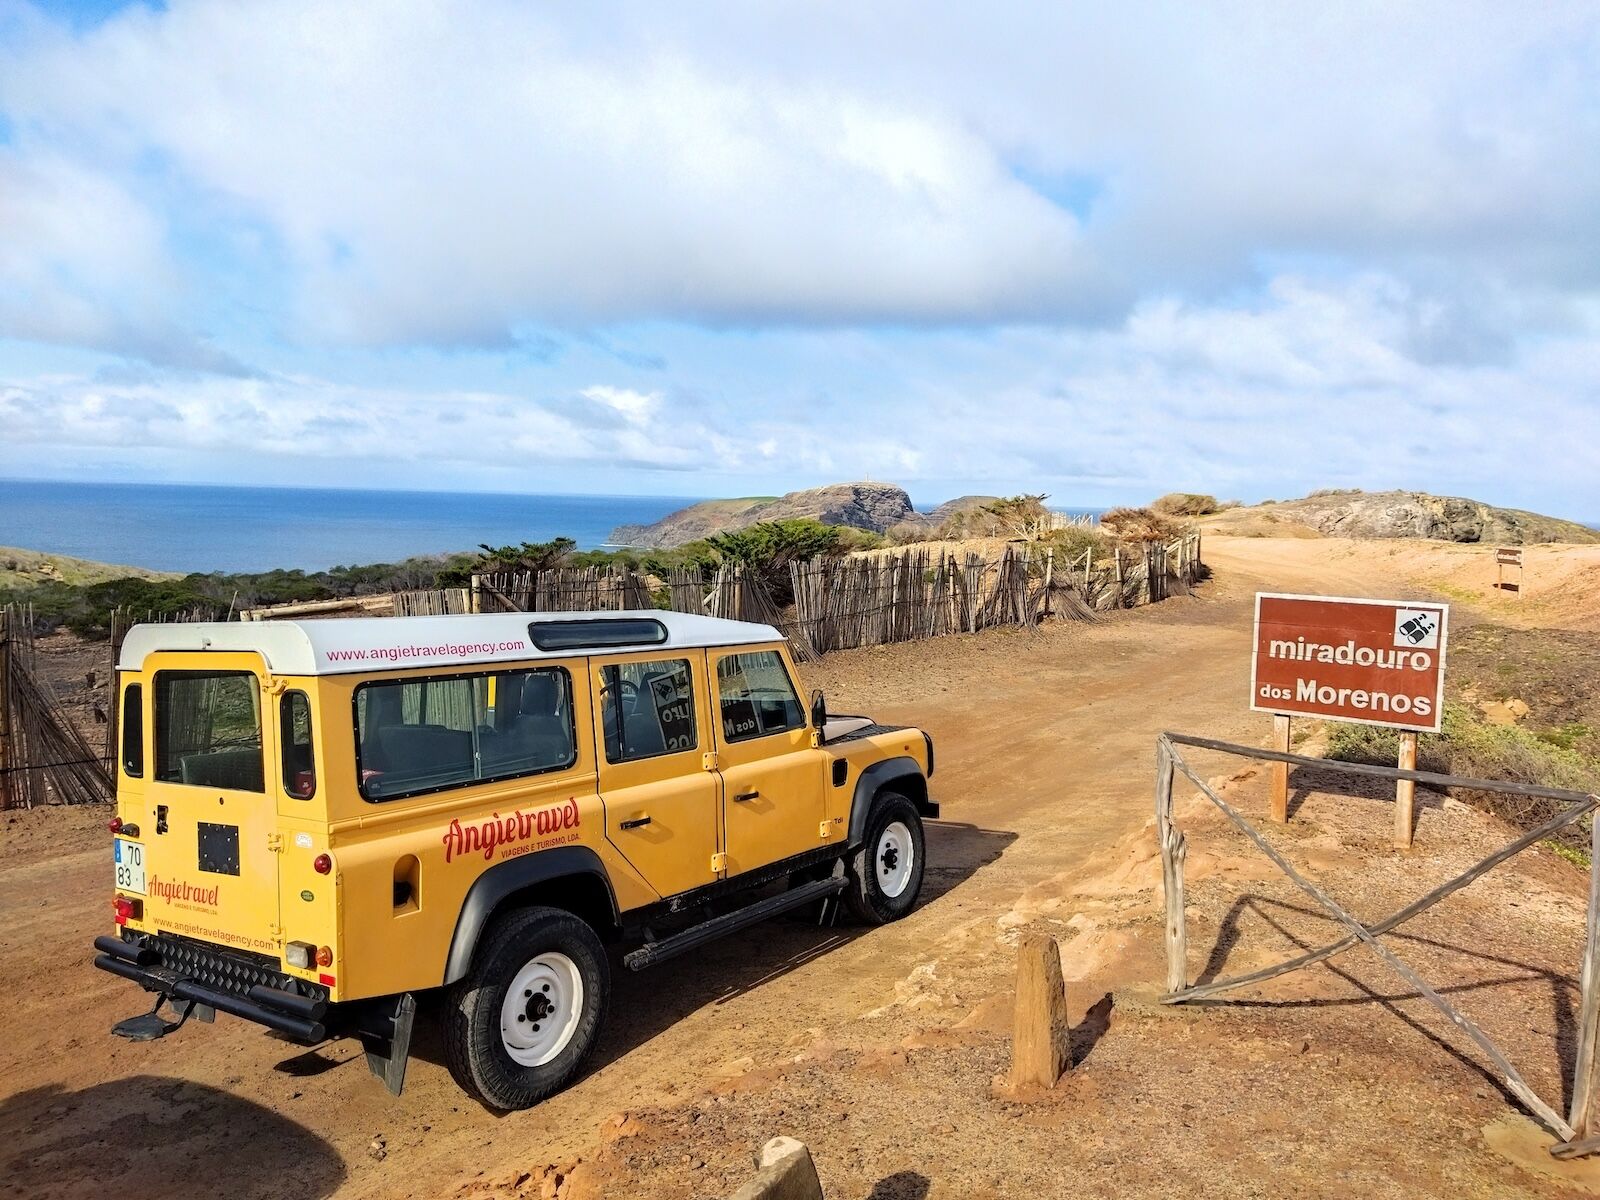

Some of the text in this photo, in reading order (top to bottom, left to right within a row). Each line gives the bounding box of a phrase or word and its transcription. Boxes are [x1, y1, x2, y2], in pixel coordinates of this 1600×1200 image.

[326, 639, 525, 661] www.angietravelagency.com
[1269, 636, 1432, 671] miradouro
[1259, 678, 1432, 716] dos Morenos
[443, 797, 580, 863] Angietravel
[127, 845, 141, 866] 70
[501, 844, 530, 858] VIAGENS
[530, 843, 535, 851] E
[148, 874, 218, 906] Angietravel
[153, 917, 274, 950] www.angietravelagency.com
